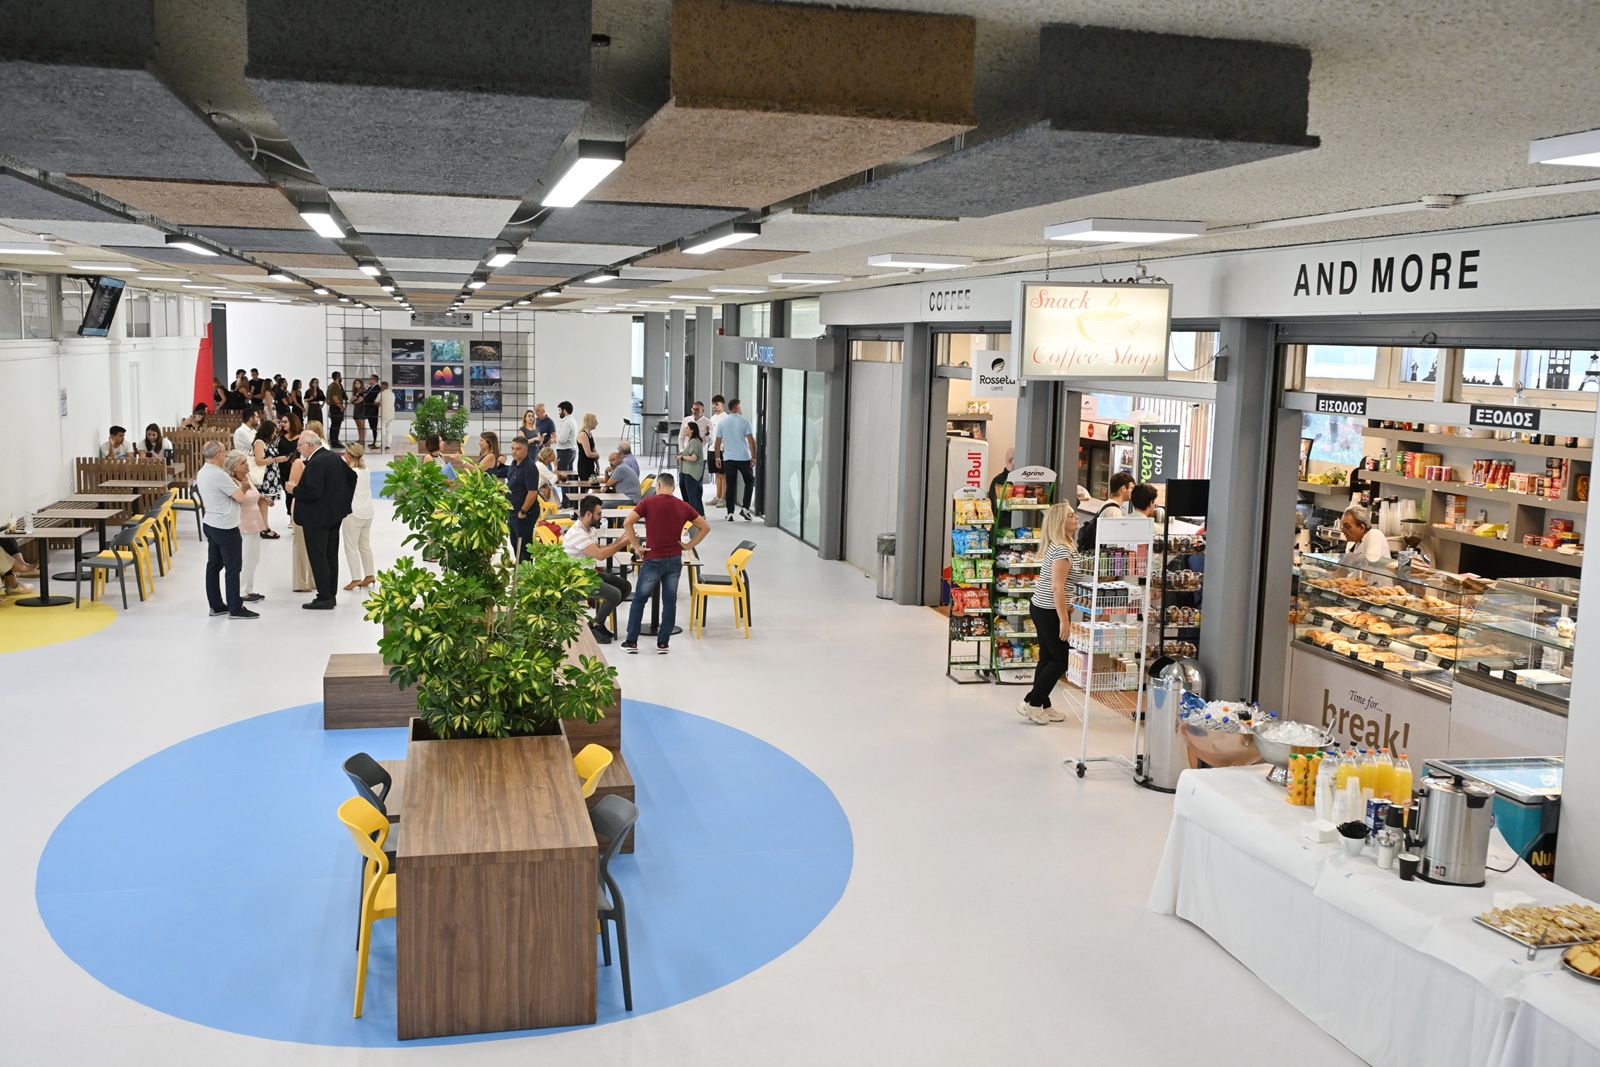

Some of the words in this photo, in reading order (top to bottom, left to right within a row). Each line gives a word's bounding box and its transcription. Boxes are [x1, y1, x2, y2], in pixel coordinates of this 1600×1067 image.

[1294, 260, 1357, 296] AND
[1372, 250, 1480, 293] MORE
[929, 289, 971, 311] COFFEE
[1031, 289, 1090, 309] Snack
[759, 346, 774, 363] STORE
[1032, 345, 1099, 371] Coffee
[1107, 345, 1158, 373] Shop
[1318, 399, 1364, 414] ΕΙΣΟΔΟΣ
[1475, 408, 1533, 428] ΕΞΟΔΟΣ
[967, 452, 982, 478] Bull
[1153, 445, 1163, 475] cola
[1349, 689, 1365, 704] Time
[1322, 688, 1410, 758] break!
